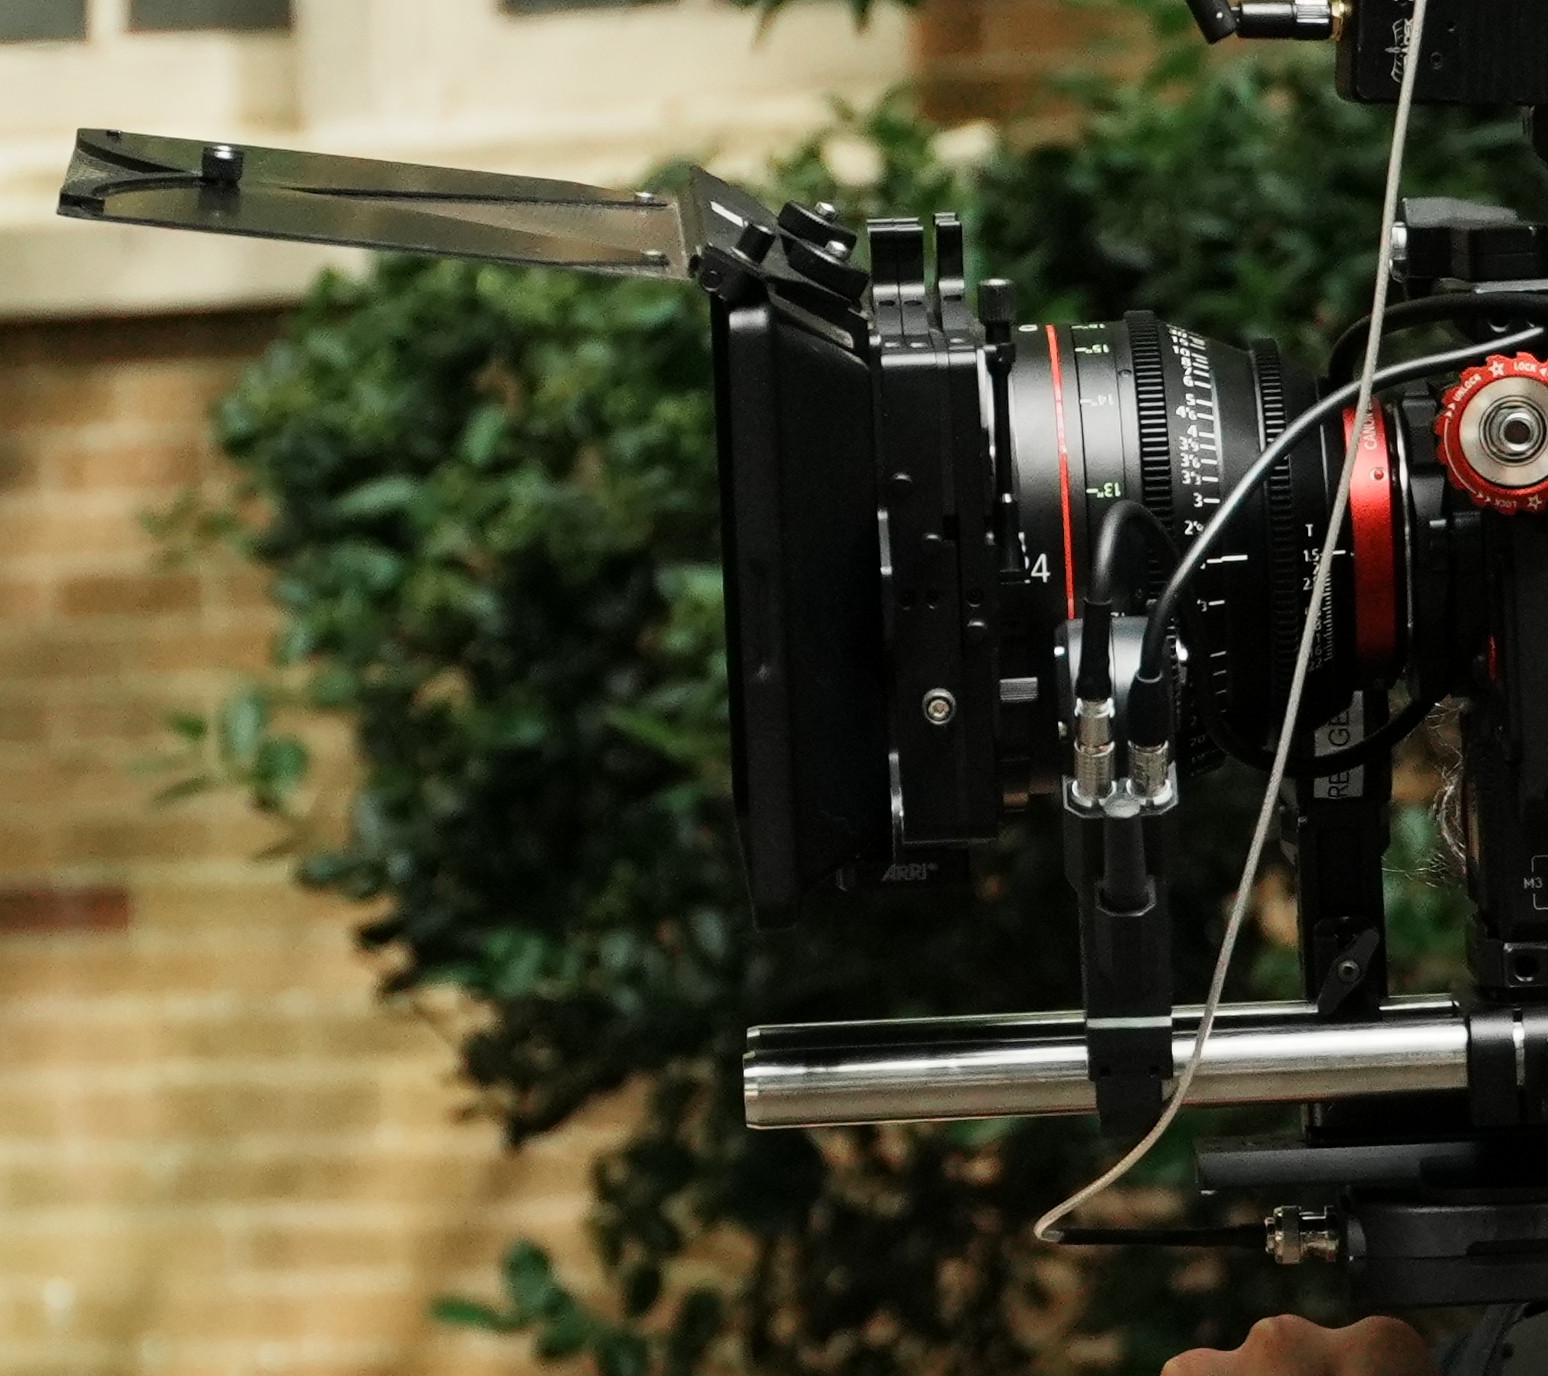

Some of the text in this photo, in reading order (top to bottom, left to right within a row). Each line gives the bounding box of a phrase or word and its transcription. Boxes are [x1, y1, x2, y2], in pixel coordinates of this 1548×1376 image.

[1513, 361, 1539, 373] LOCK
[1453, 373, 1483, 402] UNLOCK
[1185, 393, 1196, 405] 5
[1187, 424, 1198, 437] 4
[1193, 492, 1203, 508] 3
[1494, 498, 1518, 509] LOCK
[1305, 523, 1314, 537] T
[1327, 772, 1351, 799] RE
[1523, 877, 1543, 889] M3
